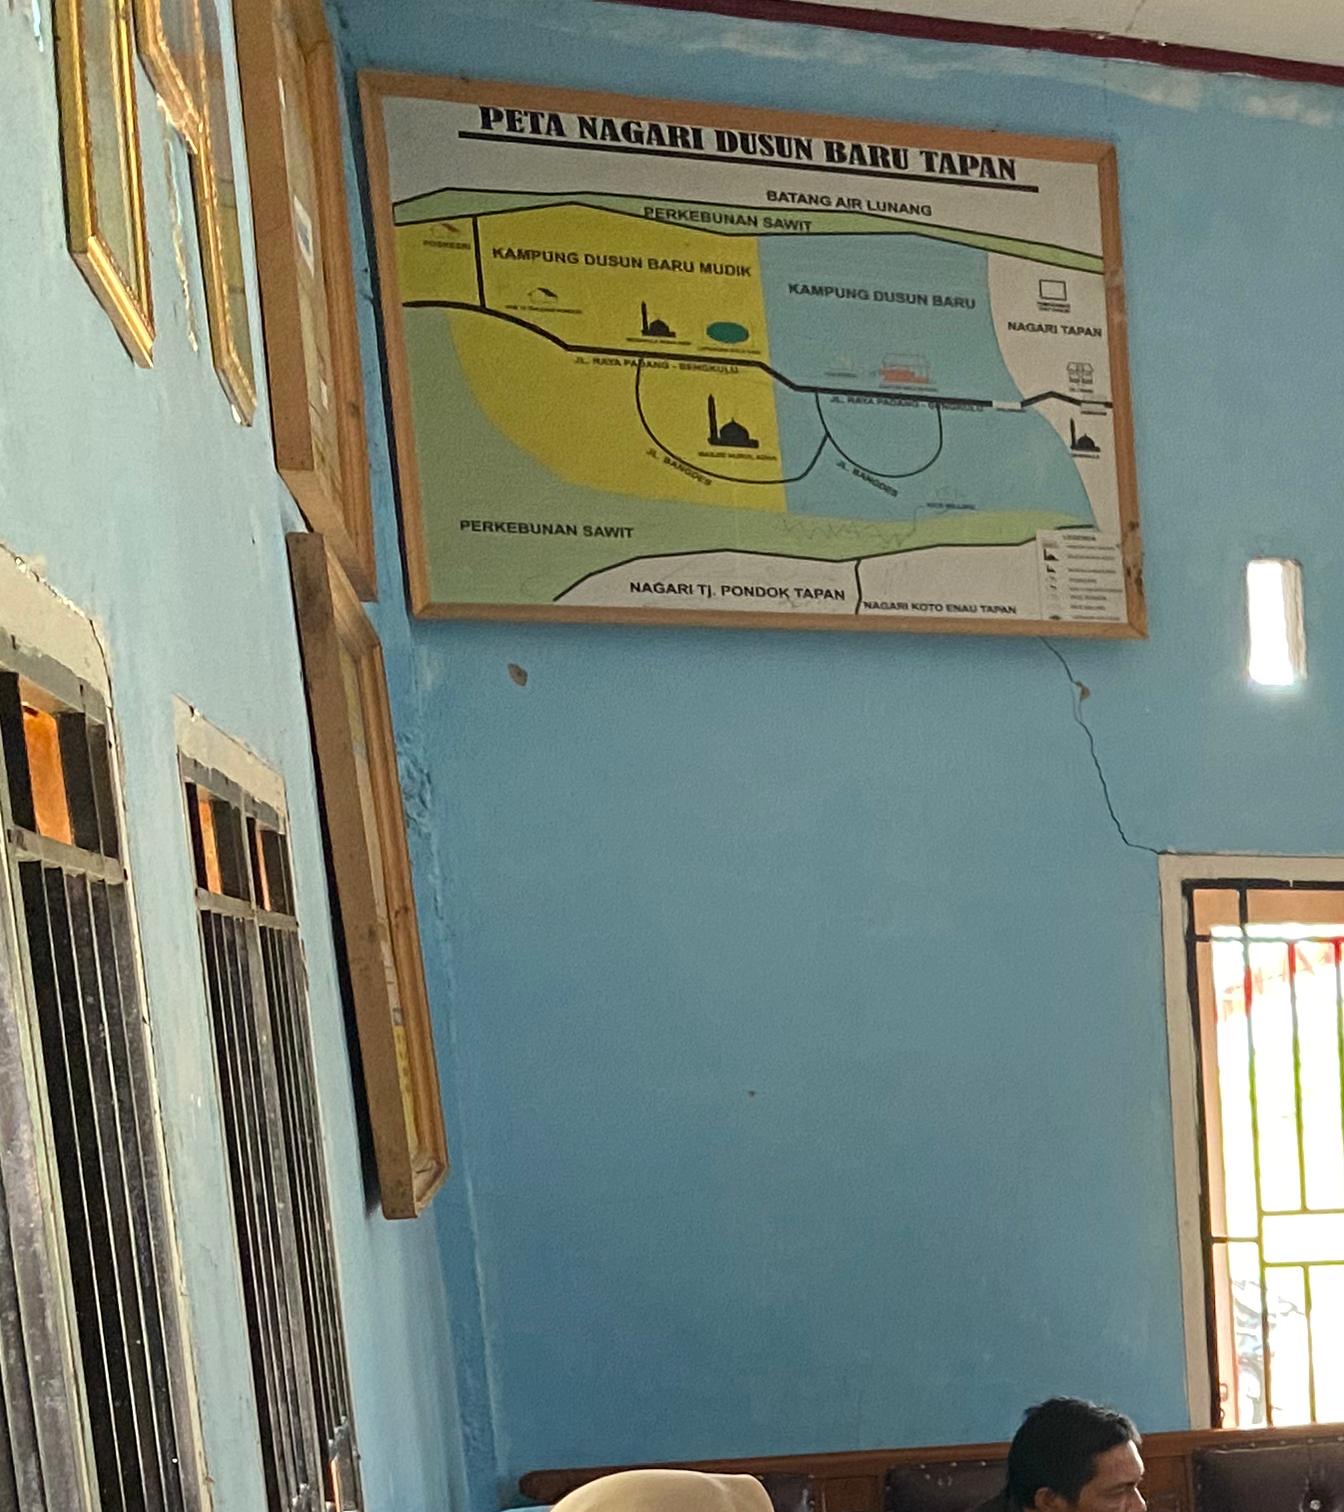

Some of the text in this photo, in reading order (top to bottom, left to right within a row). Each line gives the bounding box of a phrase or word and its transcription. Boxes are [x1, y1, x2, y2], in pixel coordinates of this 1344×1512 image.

[478, 105, 1017, 181] PETA NAGARI DUSUN BARU TAPAN
[766, 190, 933, 217] BATANG AIR LUNANG
[643, 206, 813, 232] PERKEBUNAN SAWIT
[491, 247, 752, 277] KAMPUNG DUSUN BARU MUDIK
[787, 282, 976, 310] KAMPUNG DUSUN BARU
[1007, 321, 1103, 338] NAGARI TAPAN
[592, 357, 622, 367] RAYA
[623, 358, 670, 370] PADANG
[679, 363, 740, 374] BENGKULU
[663, 456, 713, 486] BANGDES
[852, 468, 899, 497] BANGDES
[459, 519, 635, 539] PERKEBUNAN SAWIT
[629, 581, 693, 596] NAGARI
[720, 585, 791, 600] PONDOK
[793, 587, 846, 601] TAPAN
[862, 601, 1018, 615] NAGARI KOTO ENAU TAPAN
